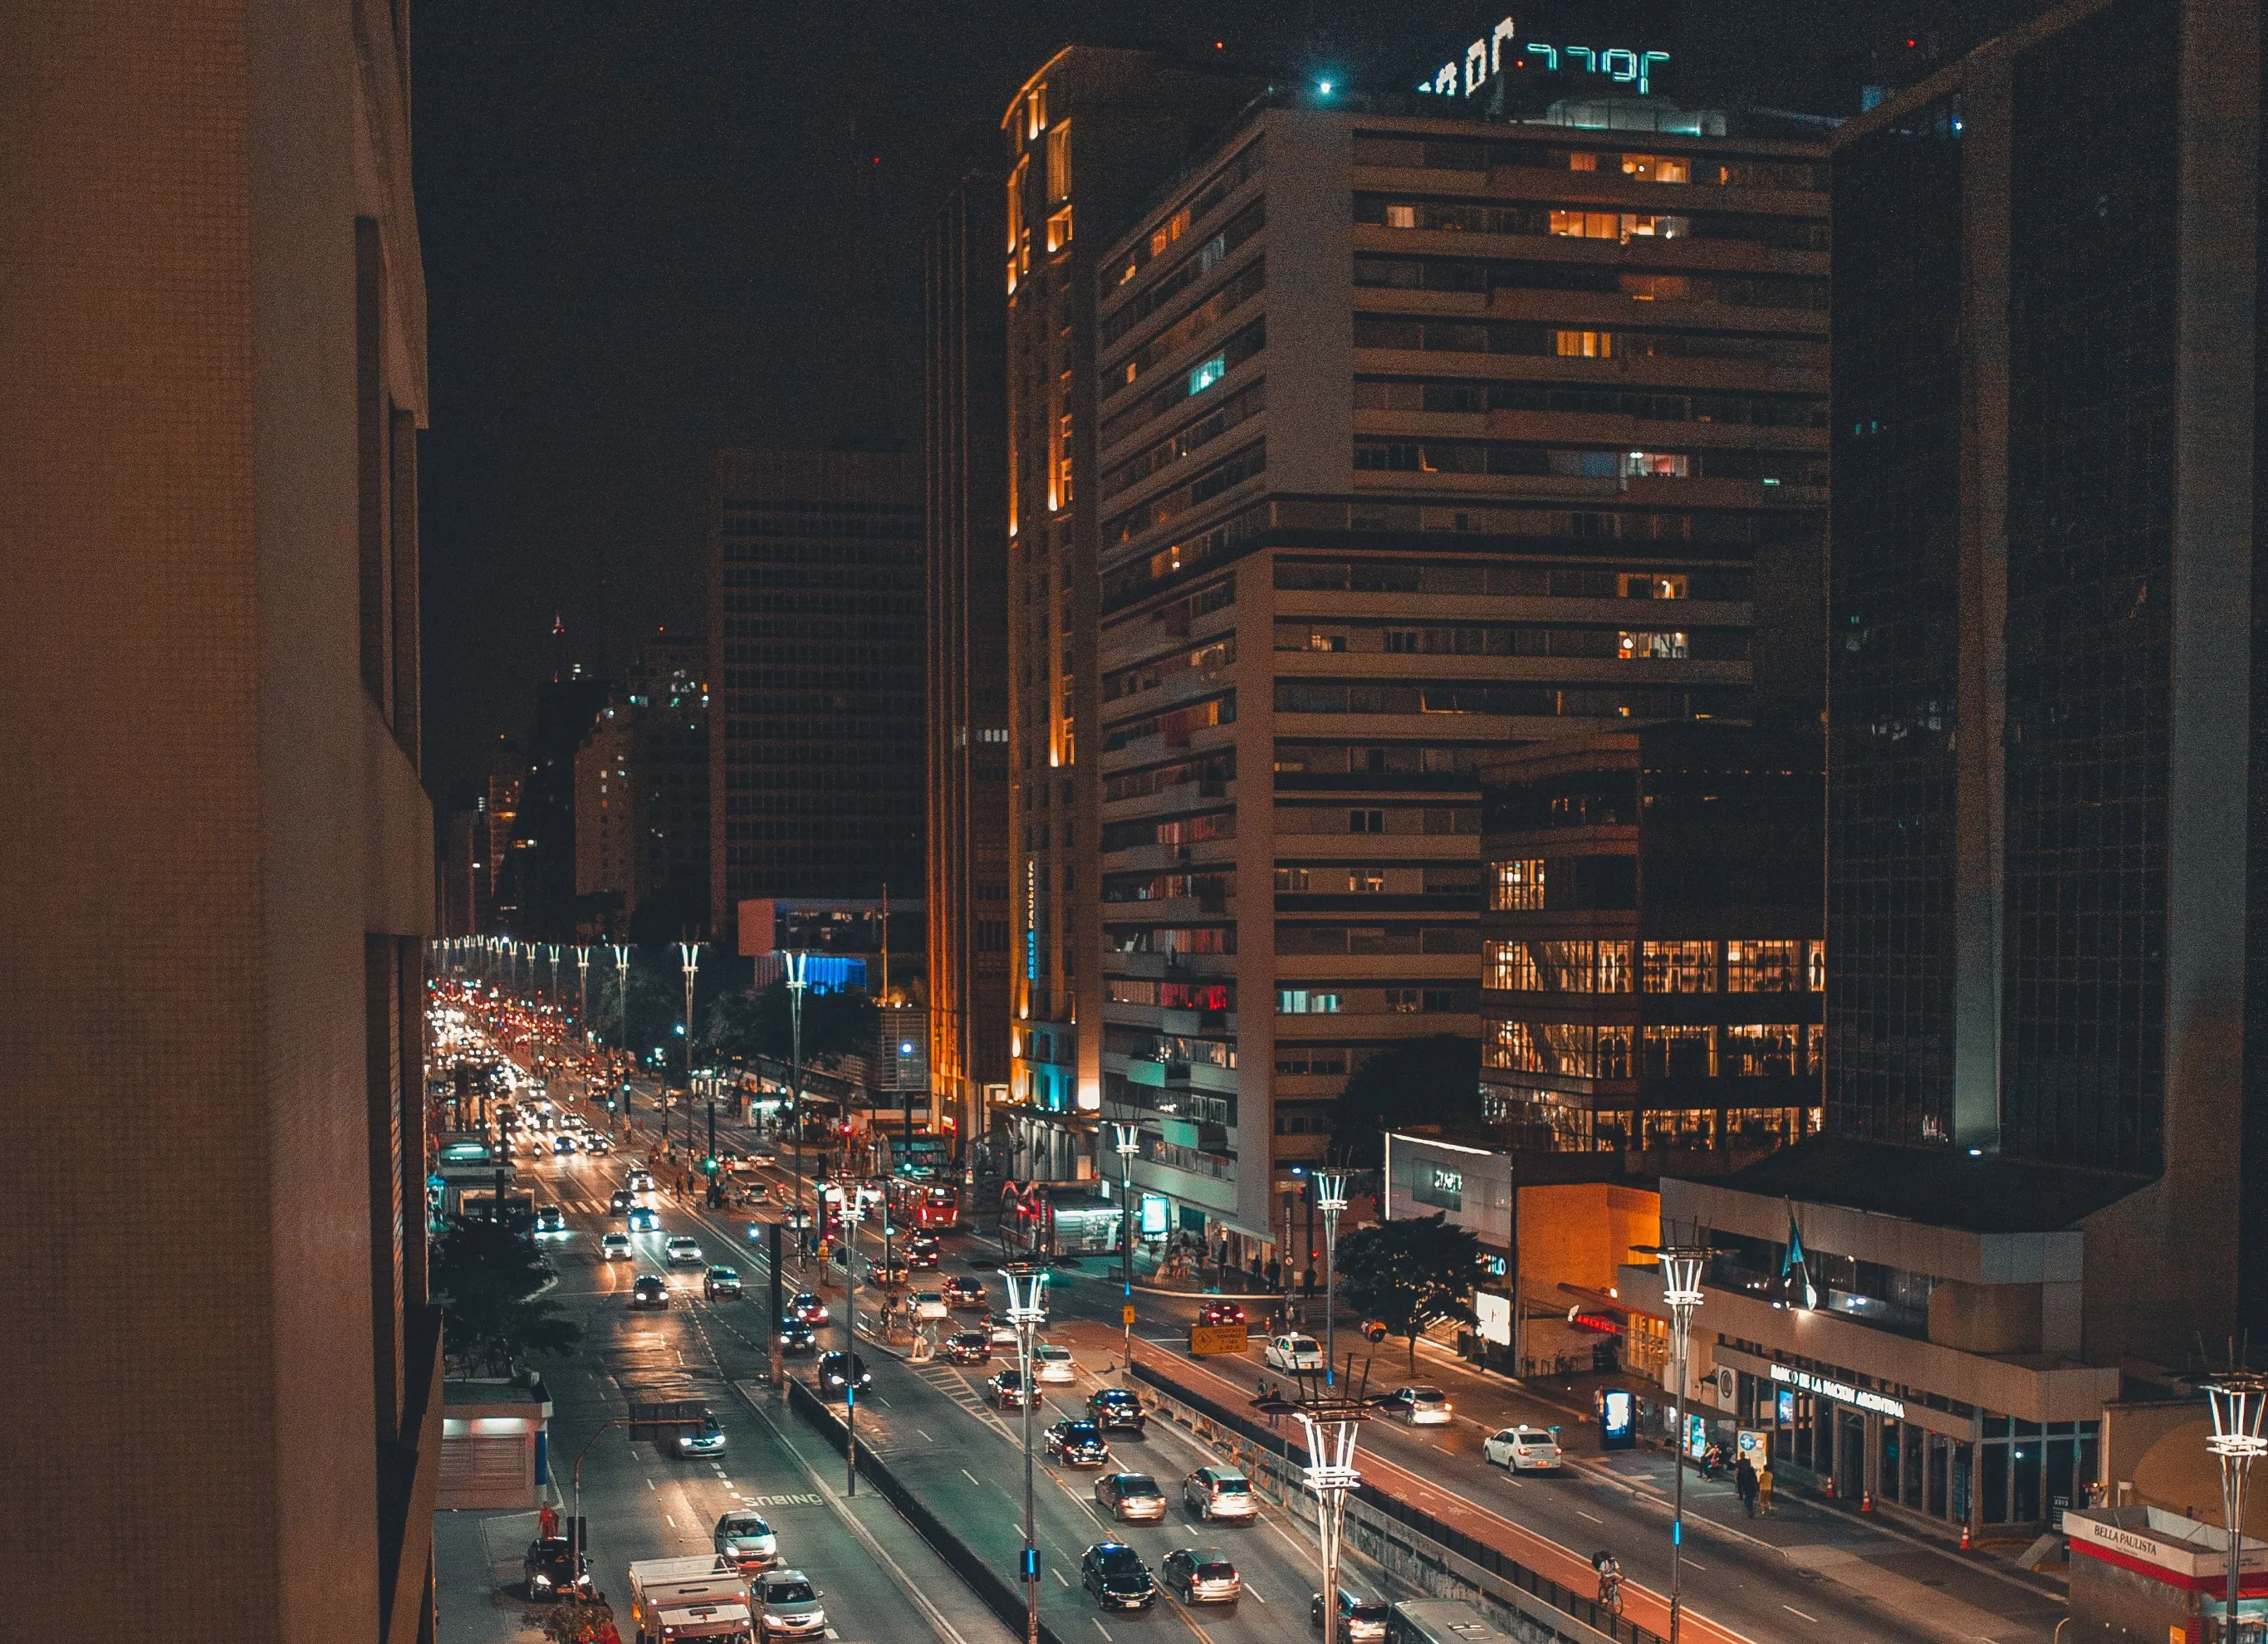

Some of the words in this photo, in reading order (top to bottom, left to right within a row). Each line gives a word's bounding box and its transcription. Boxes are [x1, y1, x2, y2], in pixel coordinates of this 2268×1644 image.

[1771, 1364, 1799, 1384] BANCO
[1799, 1372, 1810, 1389] DE
[1811, 1376, 1822, 1393] LA
[1823, 1379, 1856, 1403] NACION
[1856, 1391, 1905, 1418] ARGENTINA
[742, 1494, 824, 1506] ÔNIBUS
[2094, 1524, 2119, 1543] BELLA
[2119, 1533, 2157, 1555] PAULISTA
